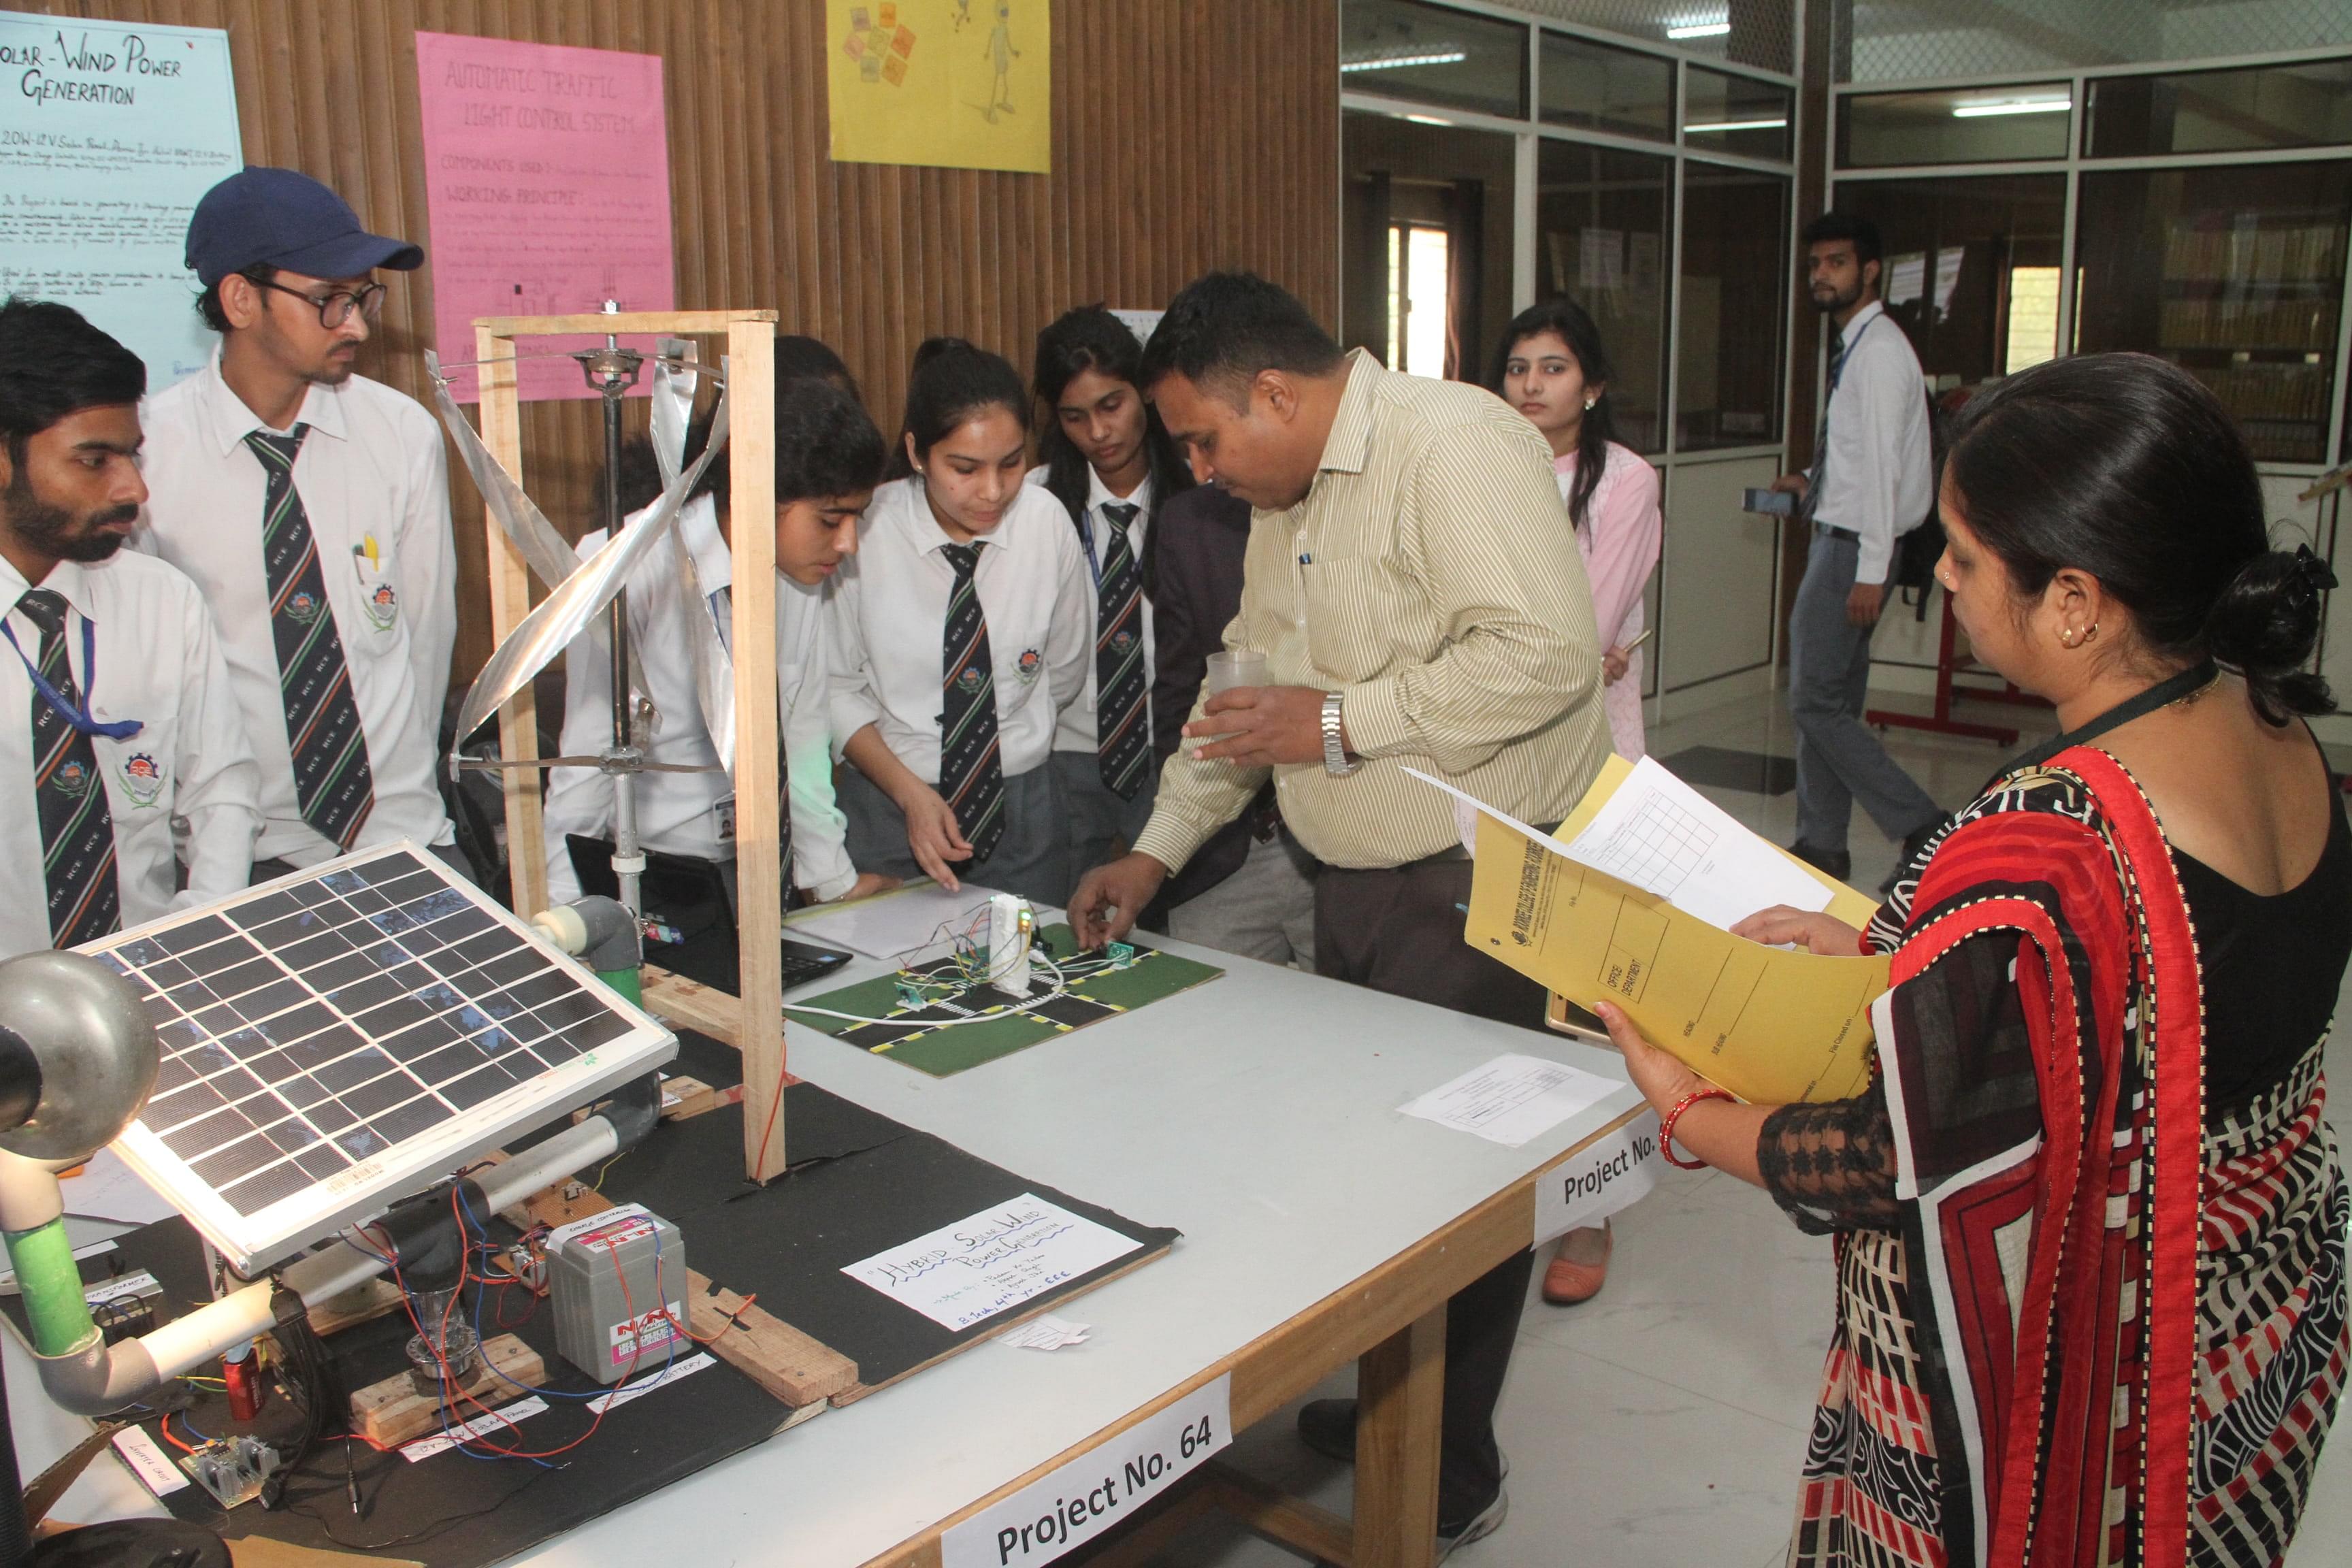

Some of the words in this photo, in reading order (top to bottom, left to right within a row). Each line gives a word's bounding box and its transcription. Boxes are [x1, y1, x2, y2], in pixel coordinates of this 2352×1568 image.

[0, 46, 44, 66] OLAR
[55, 31, 116, 72] WIND
[122, 35, 182, 77] POWER
[21, 69, 135, 105] GENERATION
[445, 61, 536, 93] AUTOMATIC
[542, 69, 619, 99] TRAFFIC
[464, 102, 512, 127] LIGHT
[517, 105, 578, 131] CONTROL
[444, 184, 512, 203] WORKING
[25, 598, 50, 612] RCE
[301, 678, 315, 696] RCE
[38, 708, 55, 727] RCE
[131, 766, 152, 774] RCE
[84, 832, 100, 852] RCE
[67, 860, 82, 880] RCE
[49, 887, 65, 908] RCE
[1622, 959, 1642, 996] DEPARTMENT
[1834, 1025, 1849, 1045] Closed
[1565, 1152, 1629, 1205] Project
[1632, 1135, 1656, 1166] No.
[952, 1247, 1007, 1267] POWER
[998, 1222, 1060, 1248] GENERATION
[1045, 1271, 1071, 1284] EEE
[997, 1477, 1118, 1566] Project
[1124, 1452, 1172, 1496] No.
[1180, 1415, 1211, 1458] 64
